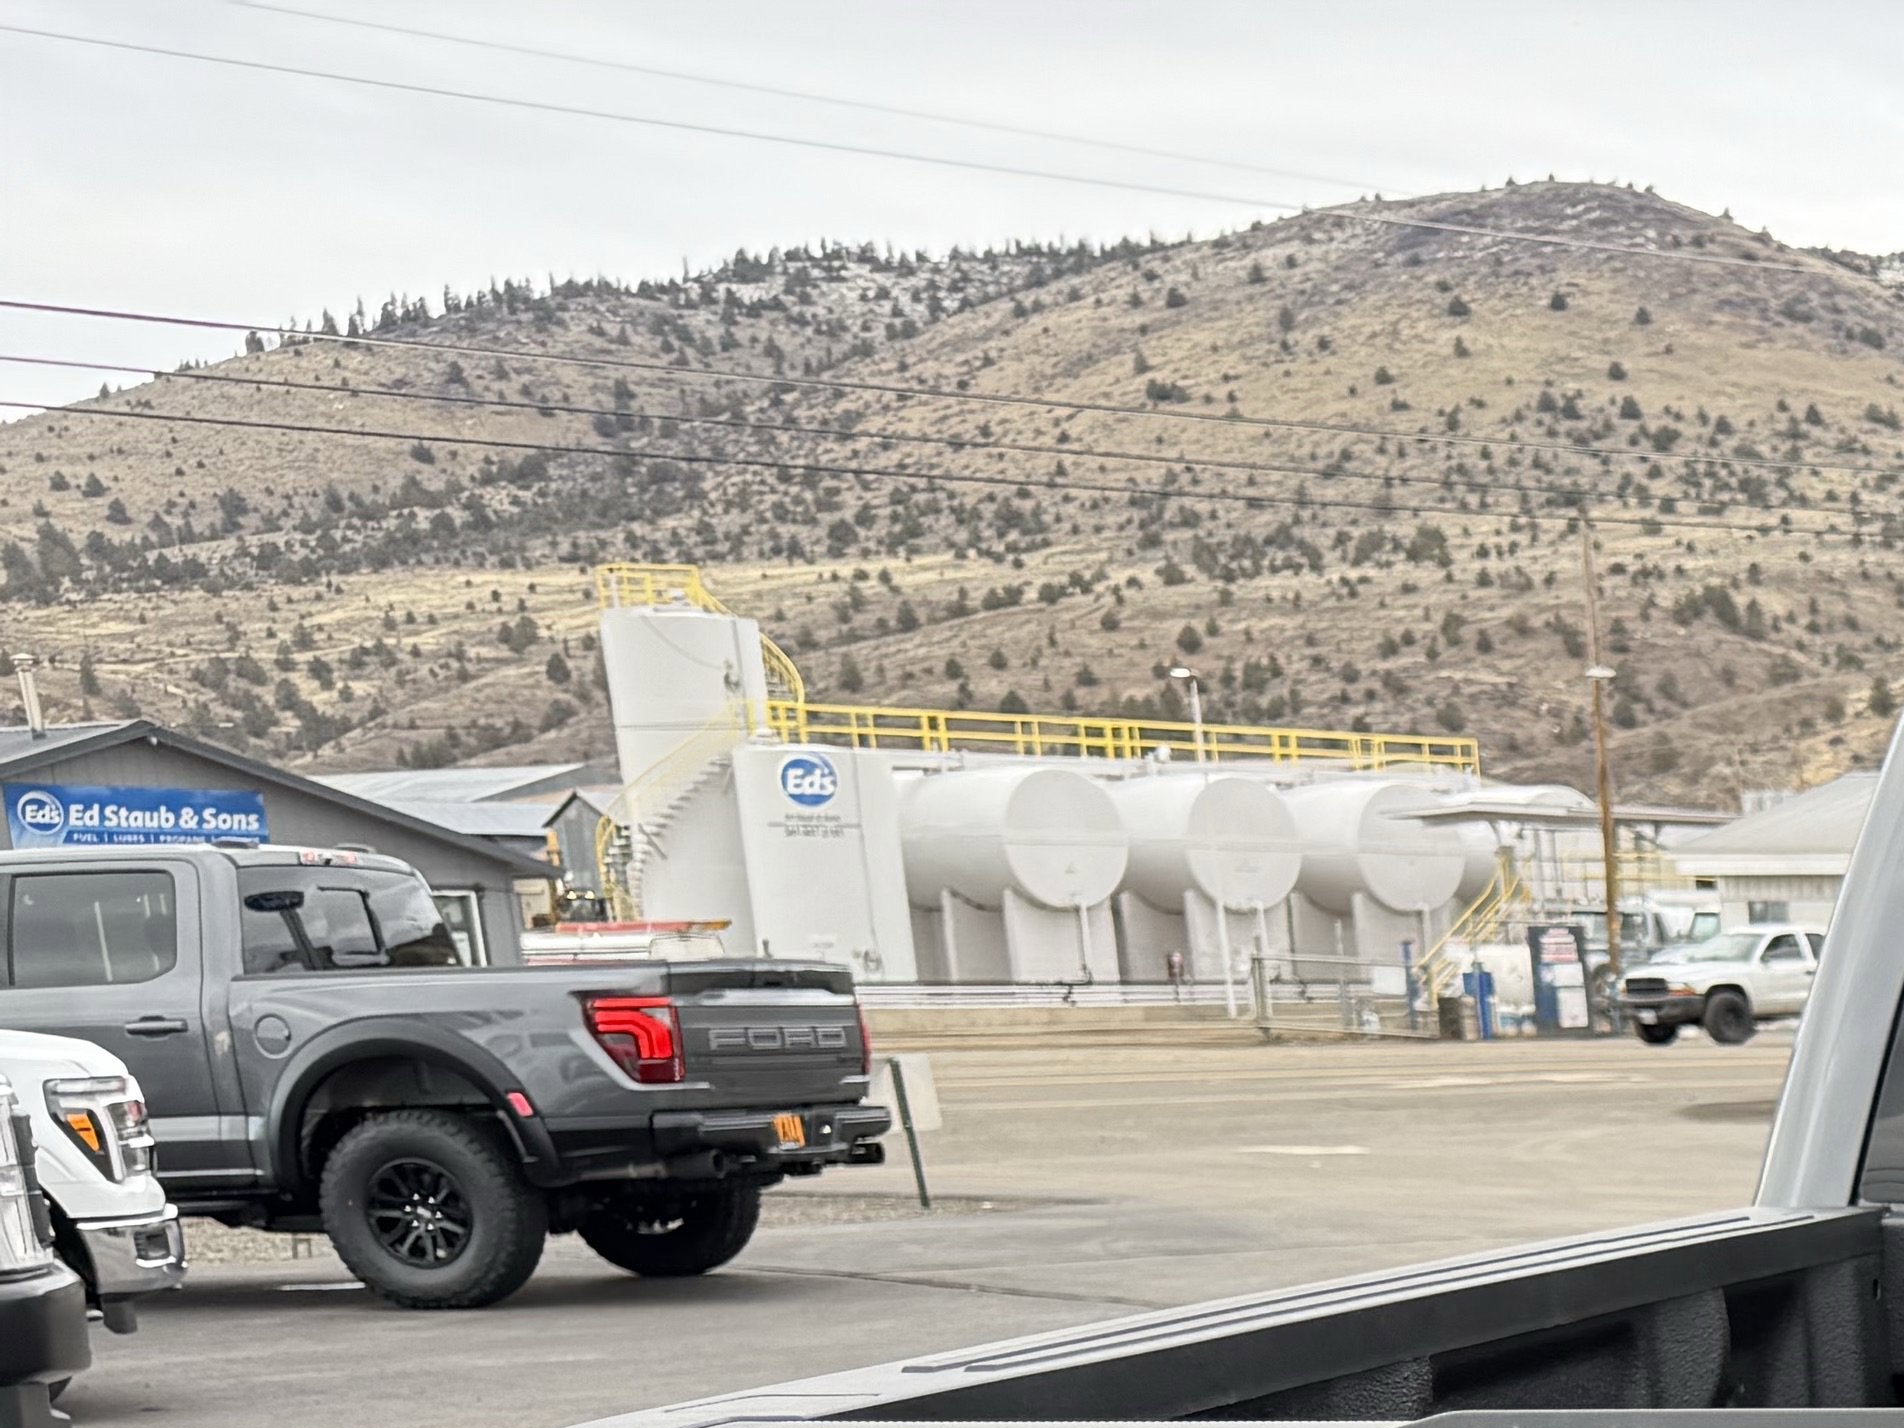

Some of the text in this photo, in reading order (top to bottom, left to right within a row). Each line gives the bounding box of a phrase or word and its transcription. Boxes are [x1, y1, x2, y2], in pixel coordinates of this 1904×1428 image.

[25, 804, 60, 824] Ed's
[69, 804, 260, 831] Ed Staub & Sons
[73, 833, 98, 843] FUEL
[708, 1027, 847, 1050] FORD
